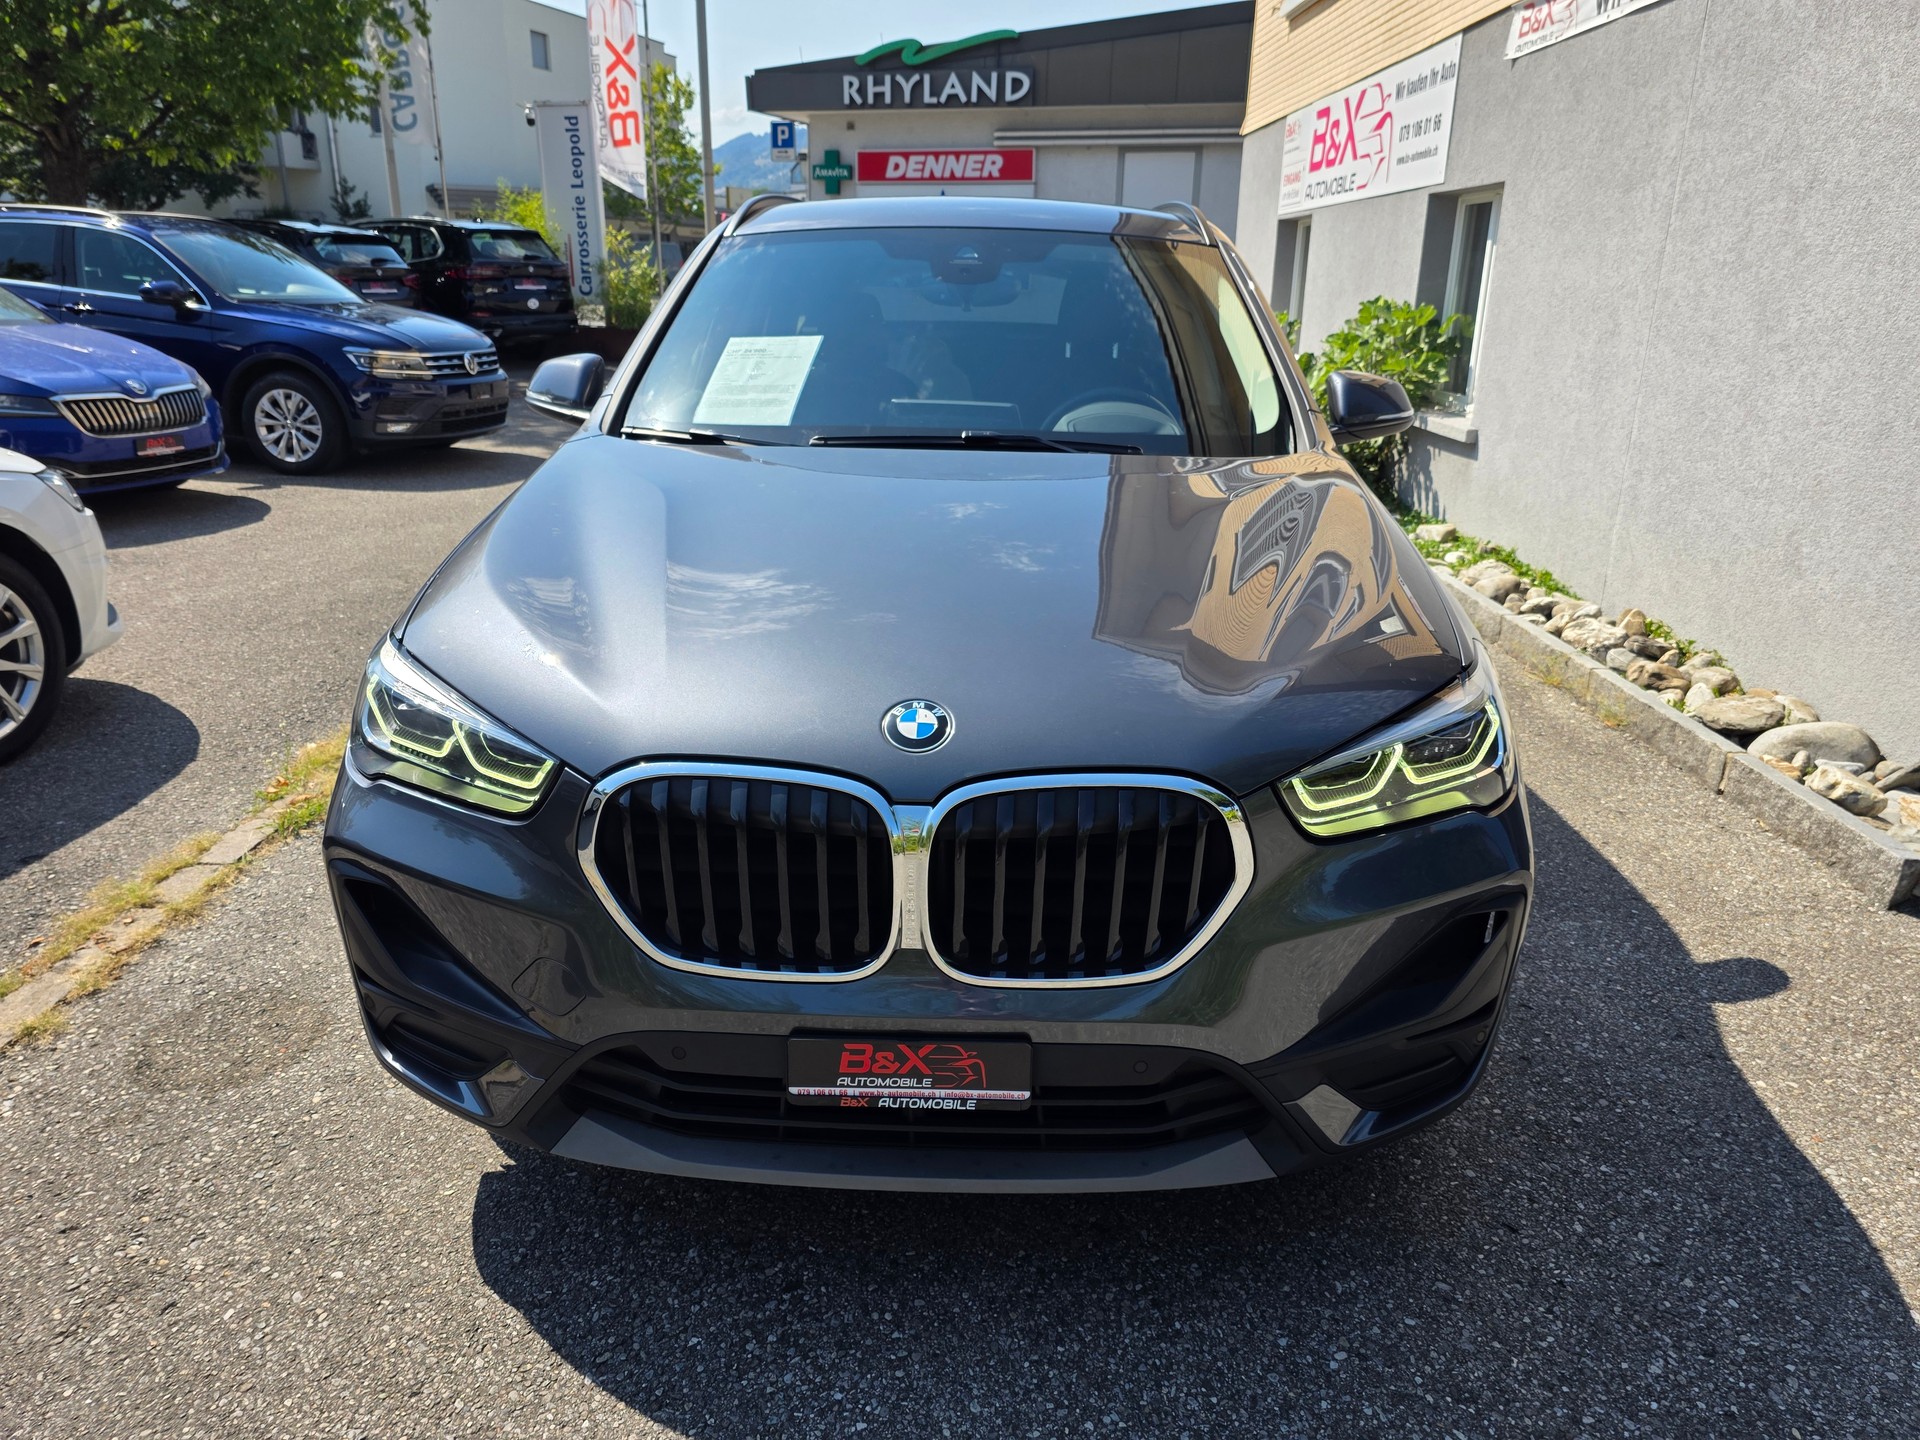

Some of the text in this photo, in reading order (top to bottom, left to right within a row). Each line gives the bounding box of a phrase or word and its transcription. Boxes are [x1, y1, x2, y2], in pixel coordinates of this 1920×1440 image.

[842, 70, 1031, 106] RHYLAND
[1395, 61, 1457, 101] Wir kaufen Ihr Auto
[777, 125, 789, 146] P
[1308, 87, 1368, 173] B&X
[1398, 113, 1442, 143] 079 106 01 66
[885, 153, 1004, 180] DENNER
[1304, 172, 1357, 202] AUTOMOBILE
[564, 115, 592, 297] Carrosserie Leopold
[892, 702, 945, 717] BMW
[838, 1043, 938, 1075] B&X
[797, 1089, 1026, 1100] 079 106 01 66 www.bx-automobile.ch info@bx-automobile.ch
[836, 1077, 933, 1088] AUTOMOBILE
[839, 1097, 977, 1111] B&X AUTOMOBILE
